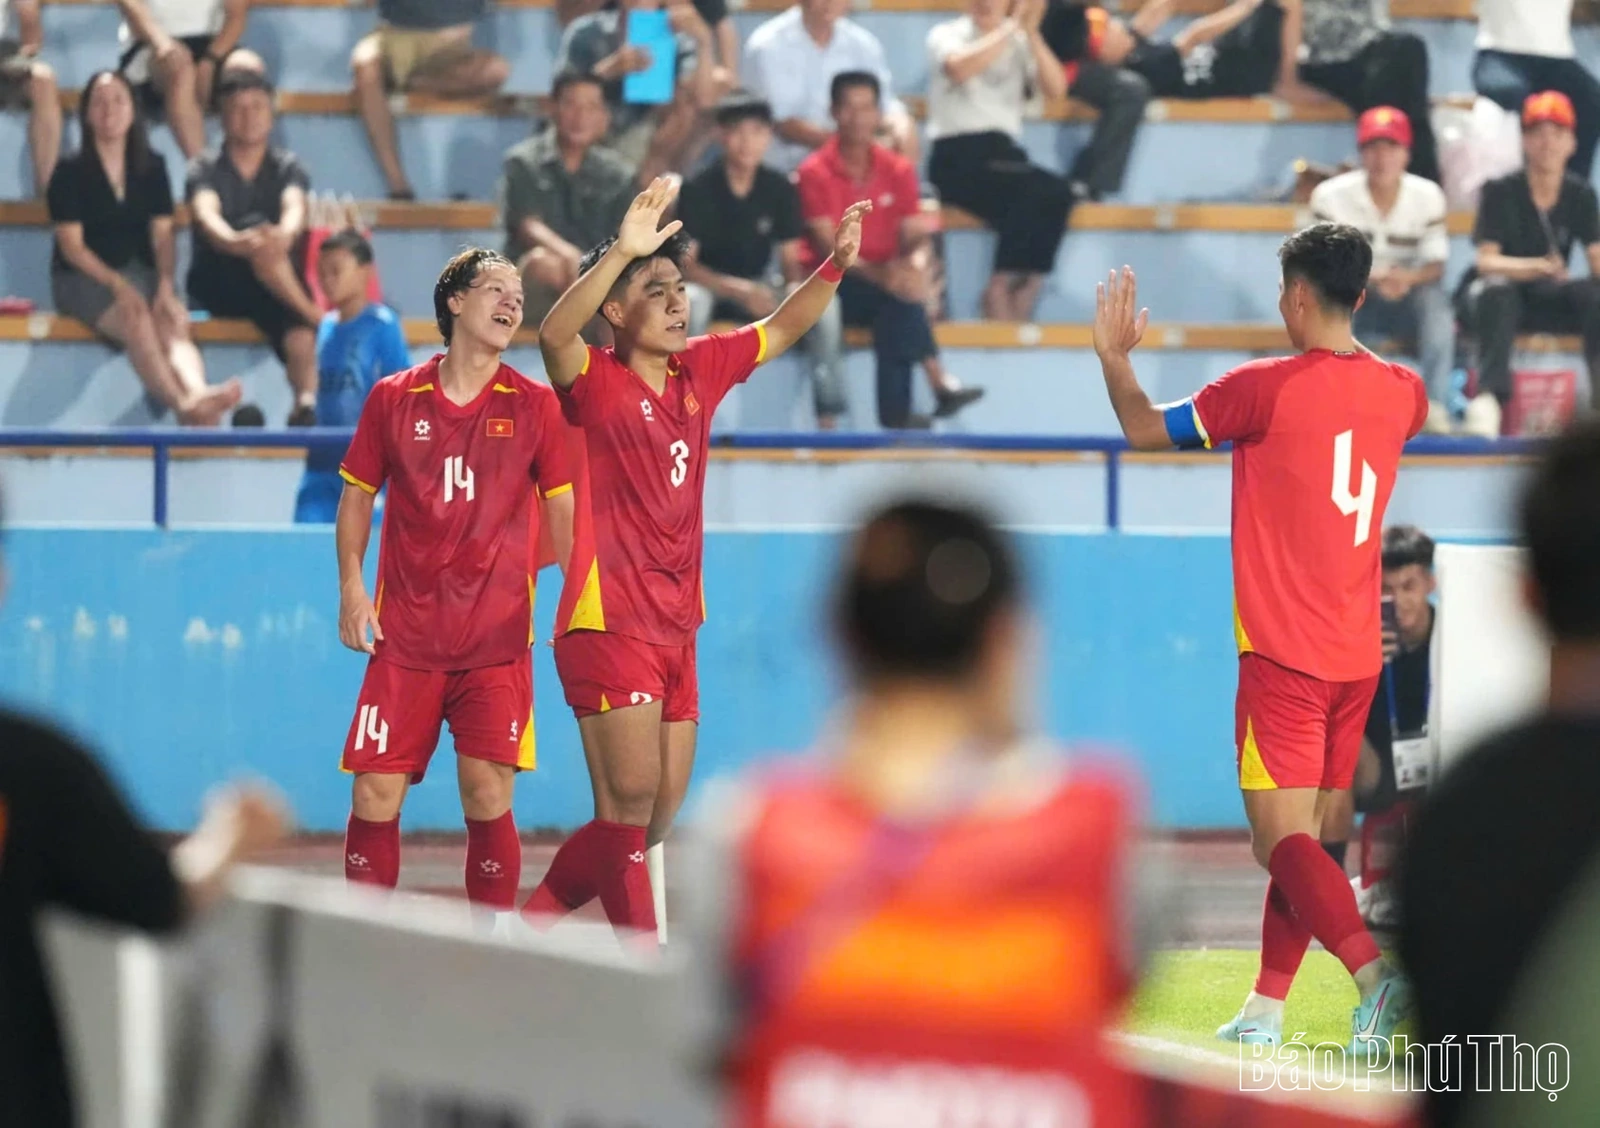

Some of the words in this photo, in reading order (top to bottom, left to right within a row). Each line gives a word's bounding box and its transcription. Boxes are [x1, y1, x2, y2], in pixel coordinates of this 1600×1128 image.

[444, 455, 475, 503] 14
[669, 439, 690, 488] 3
[1331, 428, 1378, 547] 4
[354, 704, 389, 754] 14
